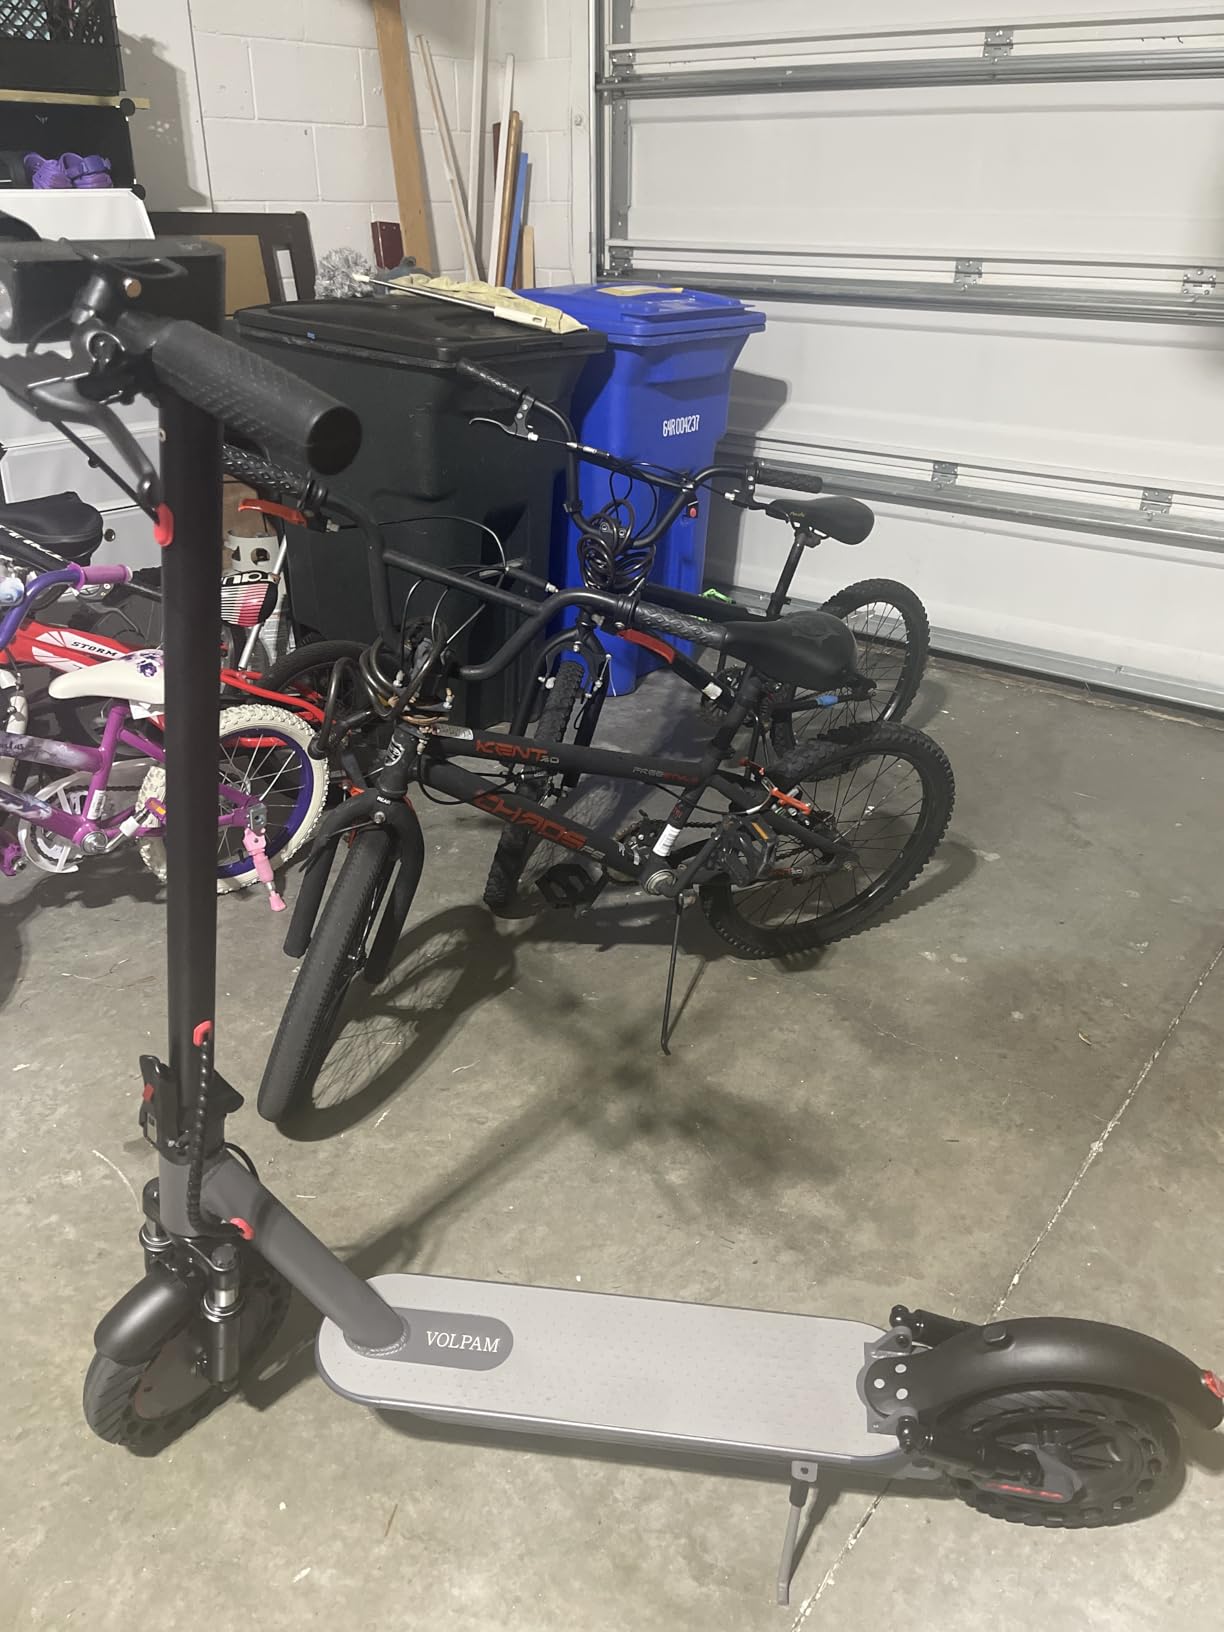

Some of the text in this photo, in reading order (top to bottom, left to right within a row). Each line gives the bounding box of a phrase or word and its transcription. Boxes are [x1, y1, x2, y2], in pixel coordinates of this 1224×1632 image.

[71, 641, 118, 656] STORM
[475, 739, 548, 761] KENT
[472, 789, 587, 849] CHAOS
[426, 1330, 501, 1353] VOLPAM
